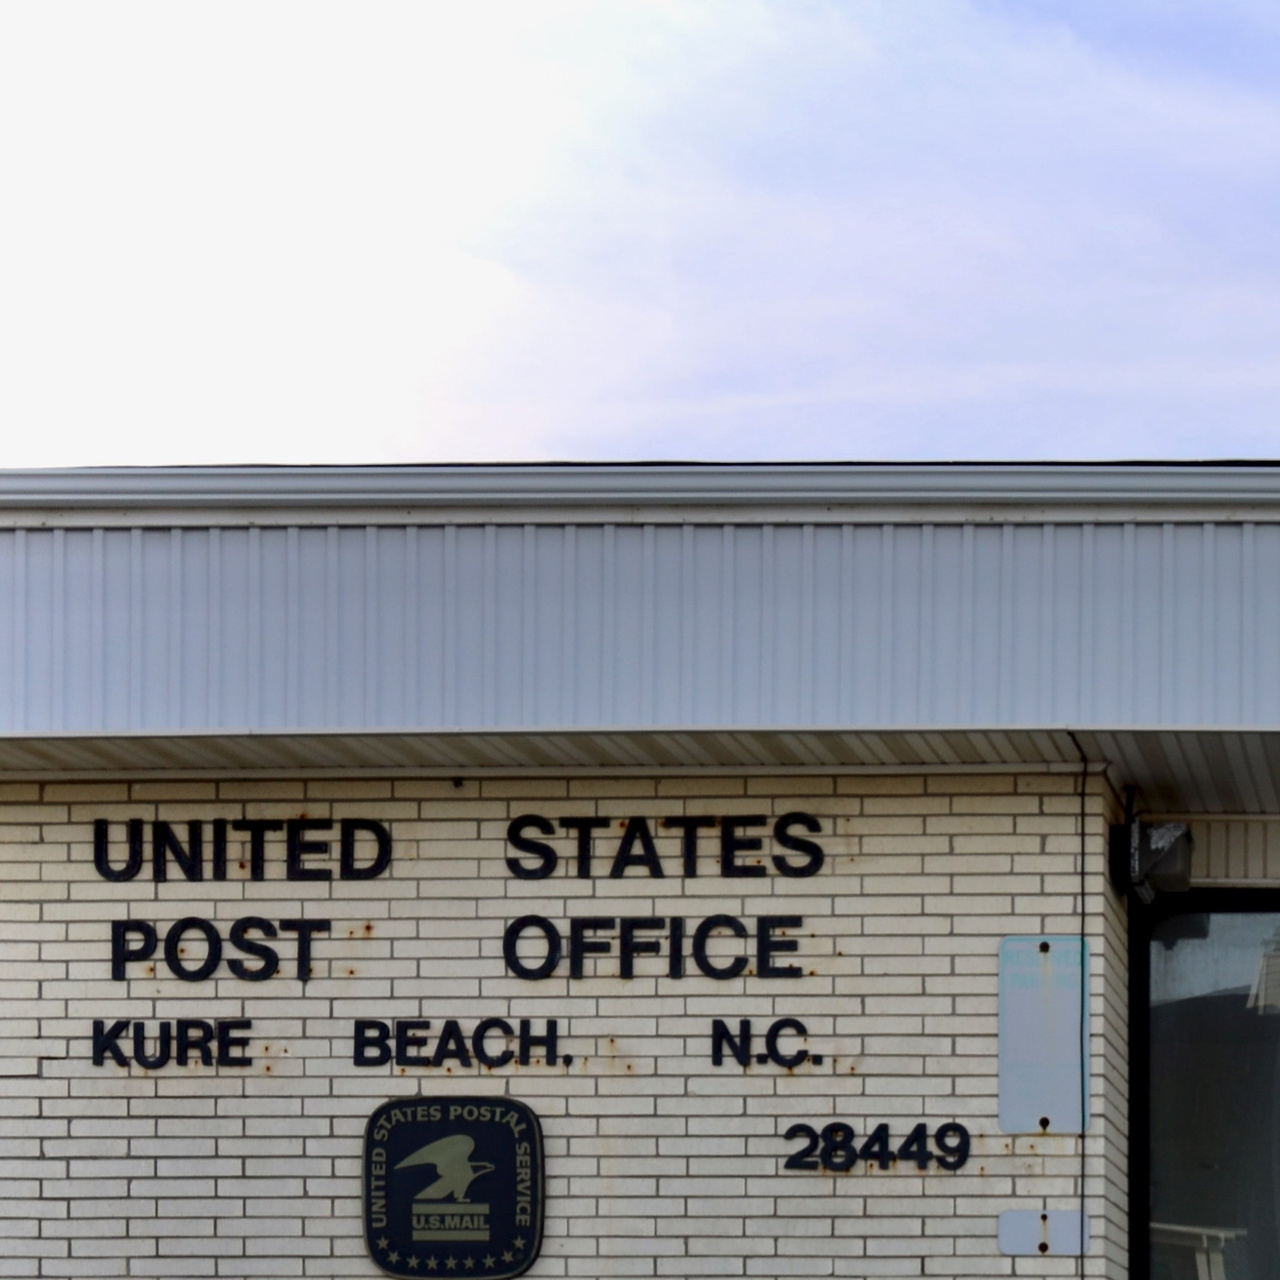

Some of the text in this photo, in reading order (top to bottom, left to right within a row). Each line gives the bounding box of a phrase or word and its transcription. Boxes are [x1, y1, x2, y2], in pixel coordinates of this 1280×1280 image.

[93, 813, 826, 882] UNITED STATES
[110, 914, 804, 982] POST OFFICE
[91, 1018, 253, 1070] KURE
[711, 1018, 824, 1067] N.C.
[371, 1105, 531, 1228] UNITED STATES POSTAL SERVICE
[783, 1122, 971, 1172] 28449
